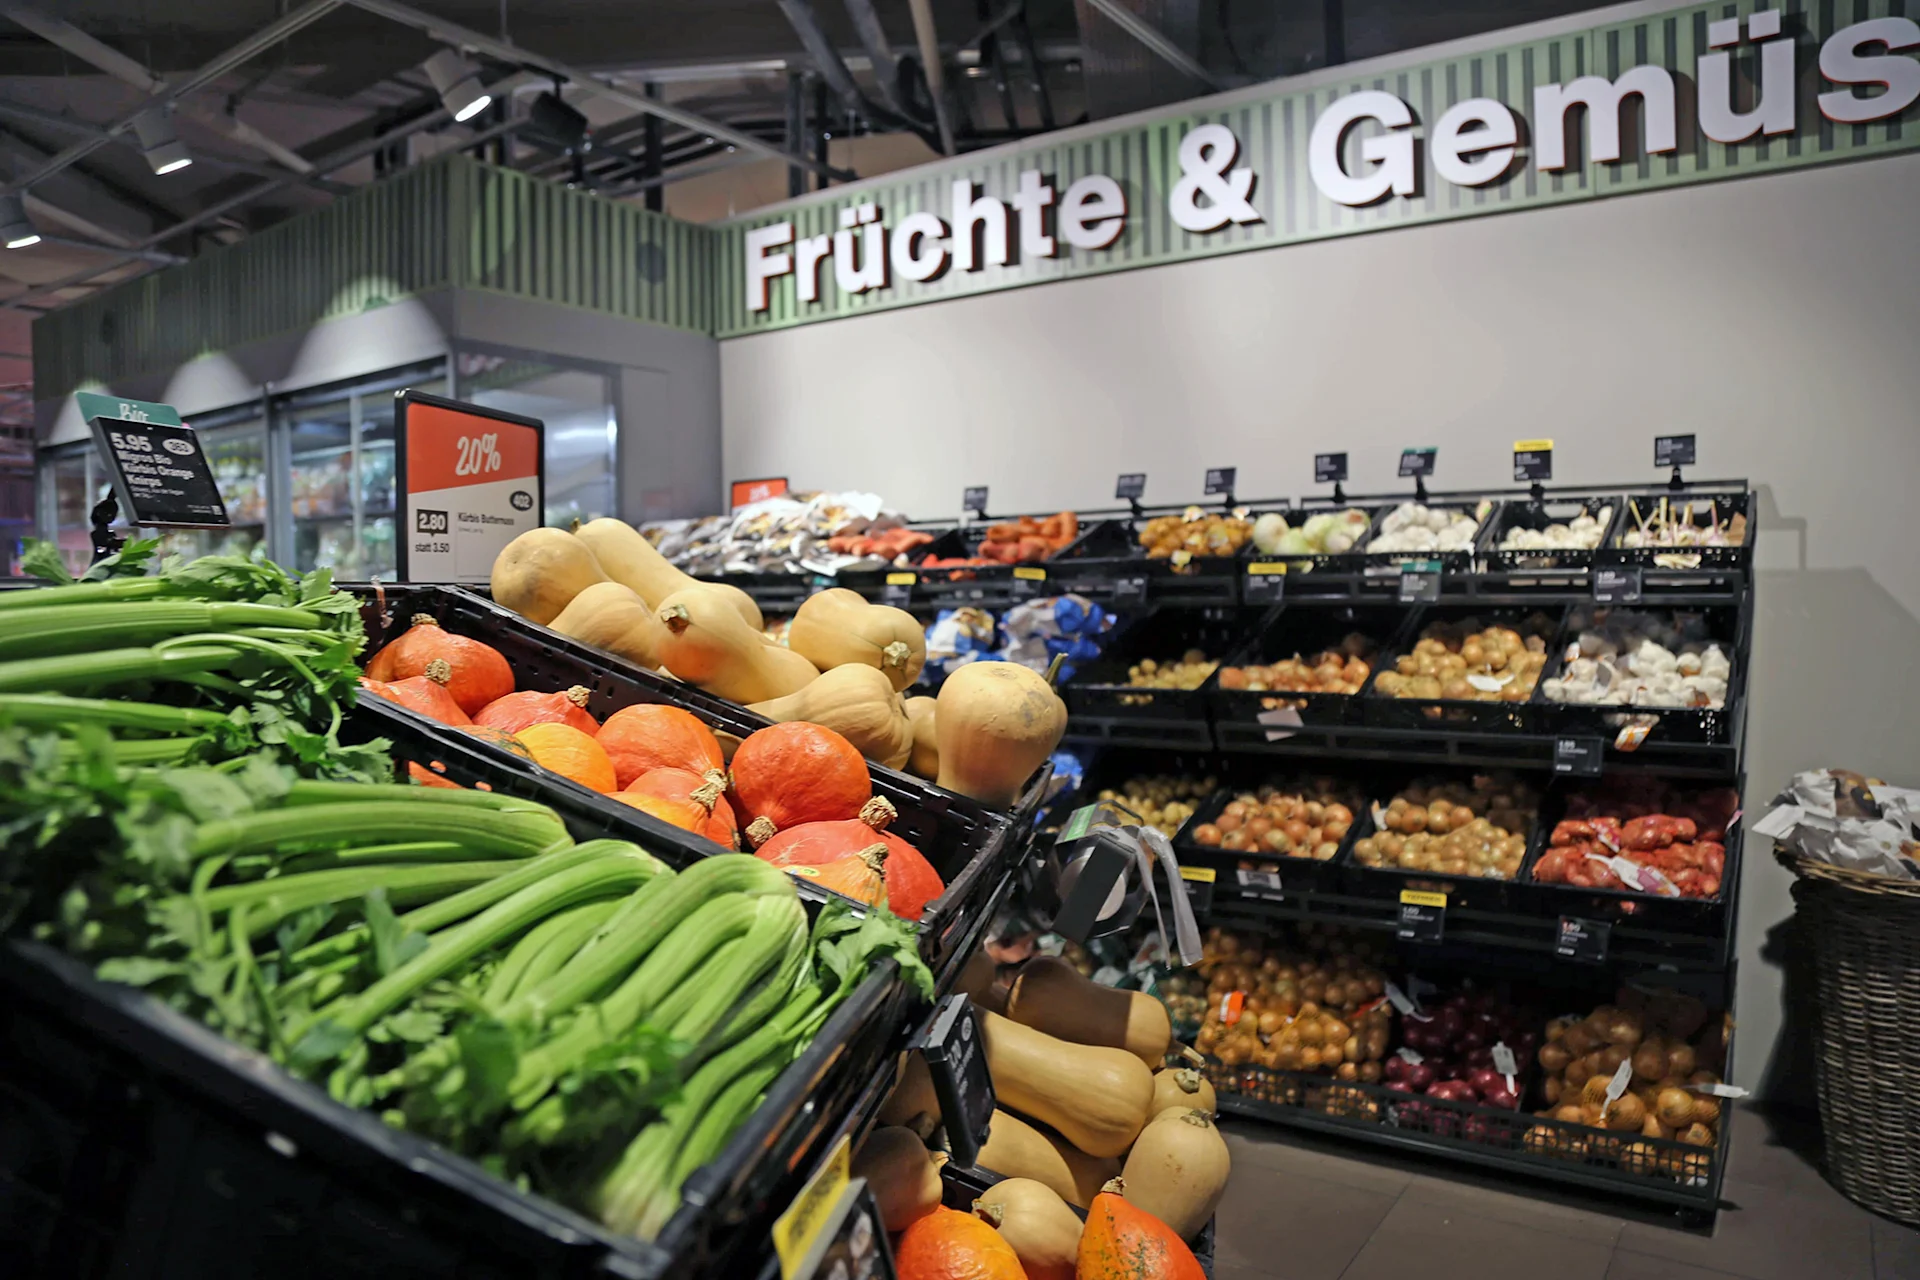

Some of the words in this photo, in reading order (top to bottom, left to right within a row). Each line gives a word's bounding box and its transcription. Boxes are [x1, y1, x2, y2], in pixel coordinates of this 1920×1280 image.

[746, 167, 1126, 311] Früchte
[1169, 124, 1260, 232] &
[1308, 9, 1920, 206] Gemüs
[119, 403, 149, 421] Bio
[110, 432, 152, 452] 5.95
[117, 450, 154, 464] Migros
[153, 454, 173, 465] Bio
[456, 433, 501, 476] 20%
[121, 462, 157, 475] Kürbis
[157, 465, 195, 480] Orange
[419, 513, 446, 530] 2.80
[432, 542, 450, 553] 3.50
